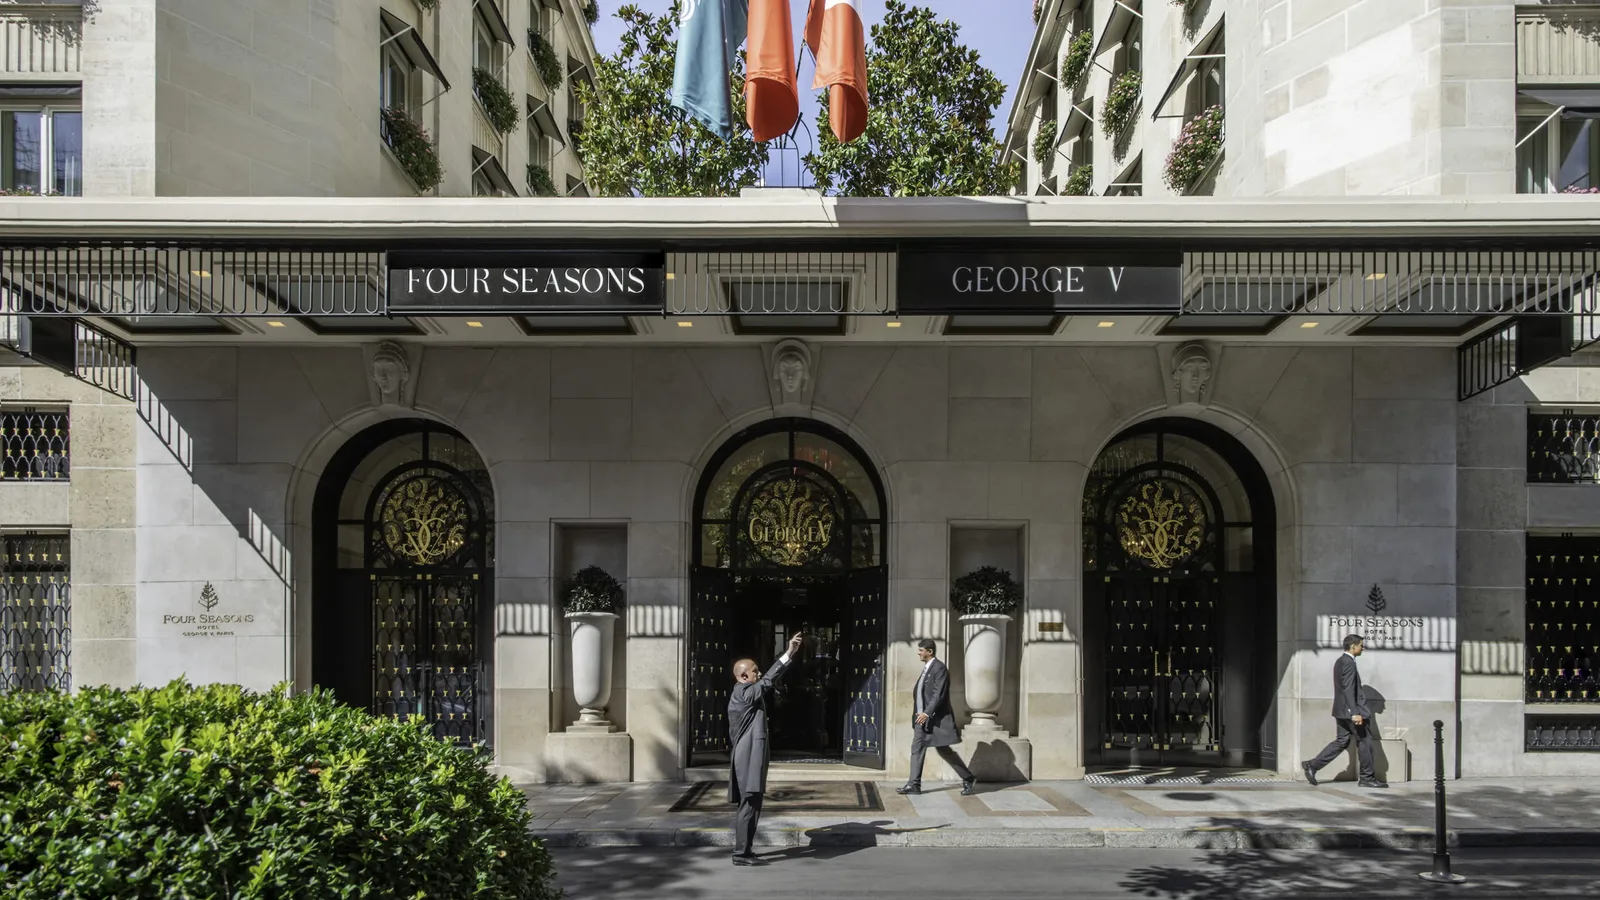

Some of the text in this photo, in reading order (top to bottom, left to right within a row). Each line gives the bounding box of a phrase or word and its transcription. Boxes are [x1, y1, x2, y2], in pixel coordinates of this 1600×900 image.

[408, 267, 645, 294] FOUR SEASONS
[952, 266, 1125, 293] GEORGE V
[163, 613, 255, 624] FOUR SEASONS
[1329, 617, 1424, 628] FOUR SEASONS
